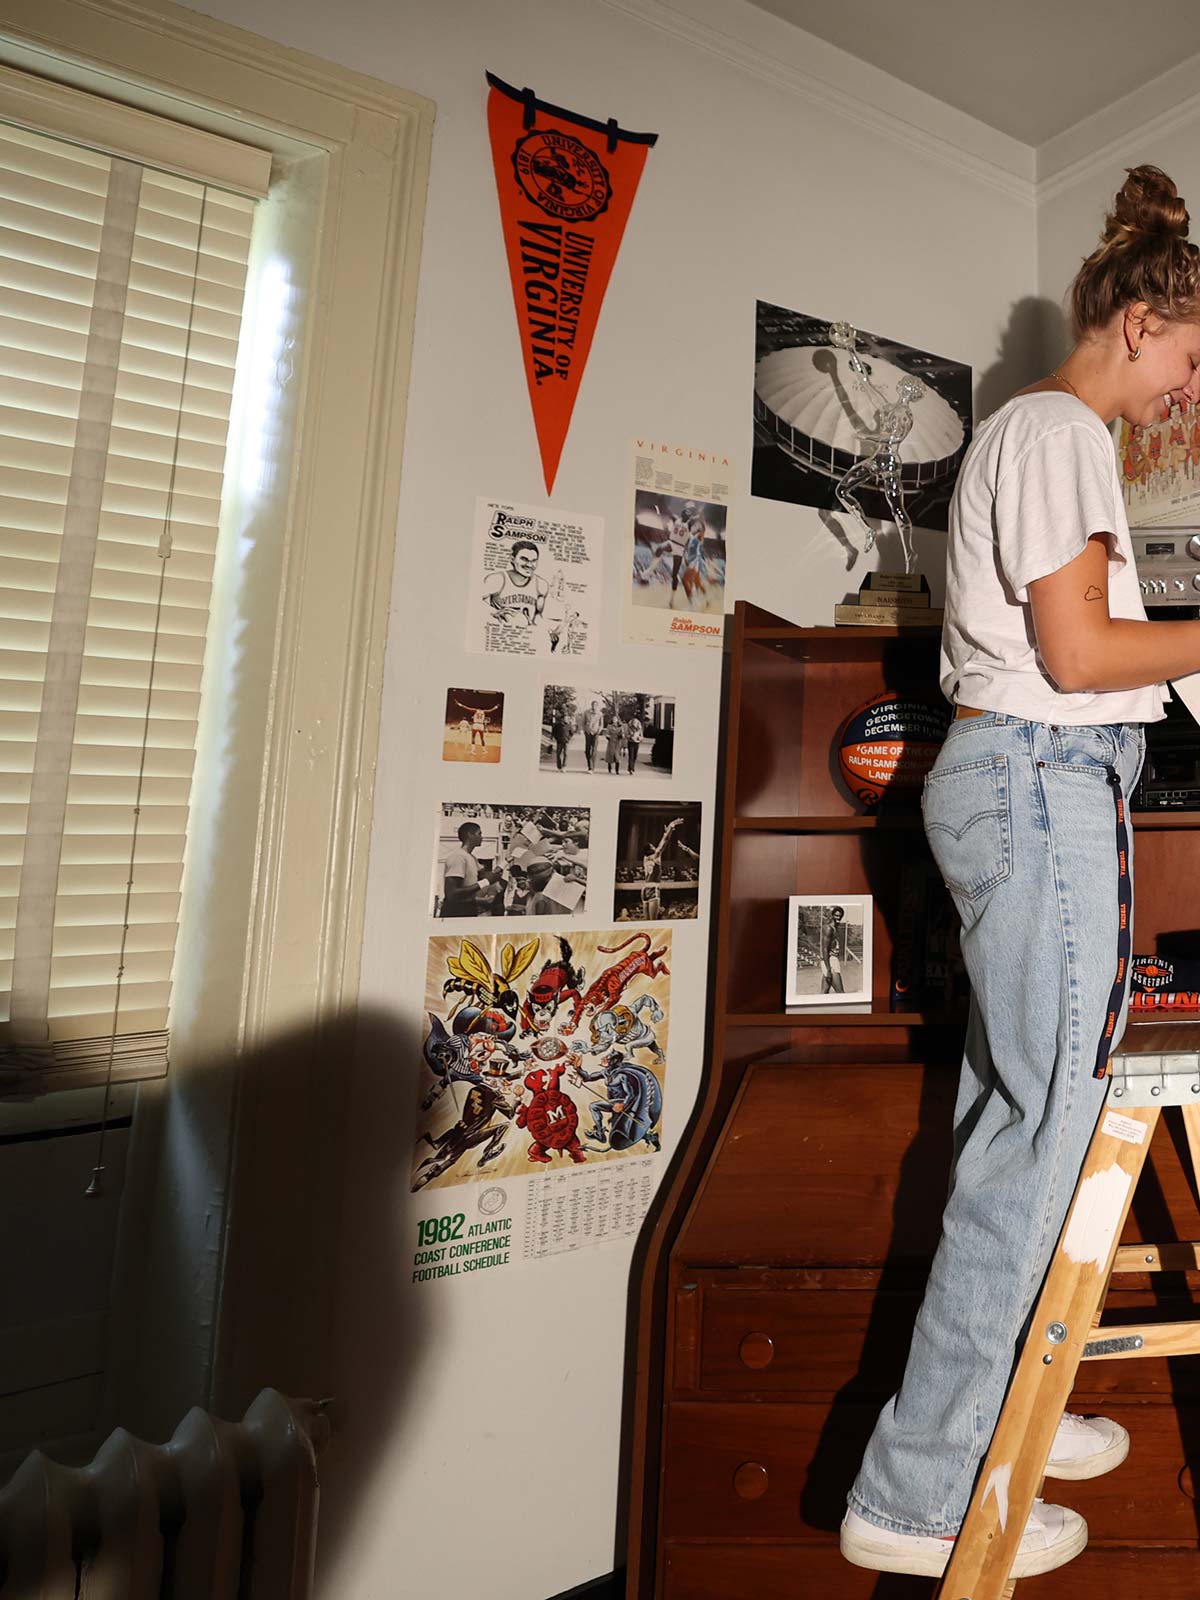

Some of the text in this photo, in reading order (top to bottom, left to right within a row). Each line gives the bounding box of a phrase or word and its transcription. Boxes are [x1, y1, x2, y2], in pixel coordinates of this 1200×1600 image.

[555, 231, 595, 381] UNIVERSITY OF
[637, 440, 729, 466] VIRGINIA
[496, 511, 534, 527] RALPH
[491, 525, 547, 543] SAMPSON
[671, 623, 720, 635] SAMPSON
[870, 703, 929, 716] VIRGINIA
[864, 723, 921, 738] DECEMBER
[890, 746, 903, 756] OF
[848, 755, 872, 768] RALPH
[1131, 972, 1174, 988] ASKETBALL
[547, 1103, 566, 1125] M
[417, 1213, 512, 1247] 1982 ATLANTIC
[414, 1235, 511, 1265] COAST CONFERENCE
[412, 1252, 510, 1284] FOOTBALL SCHEDULE
